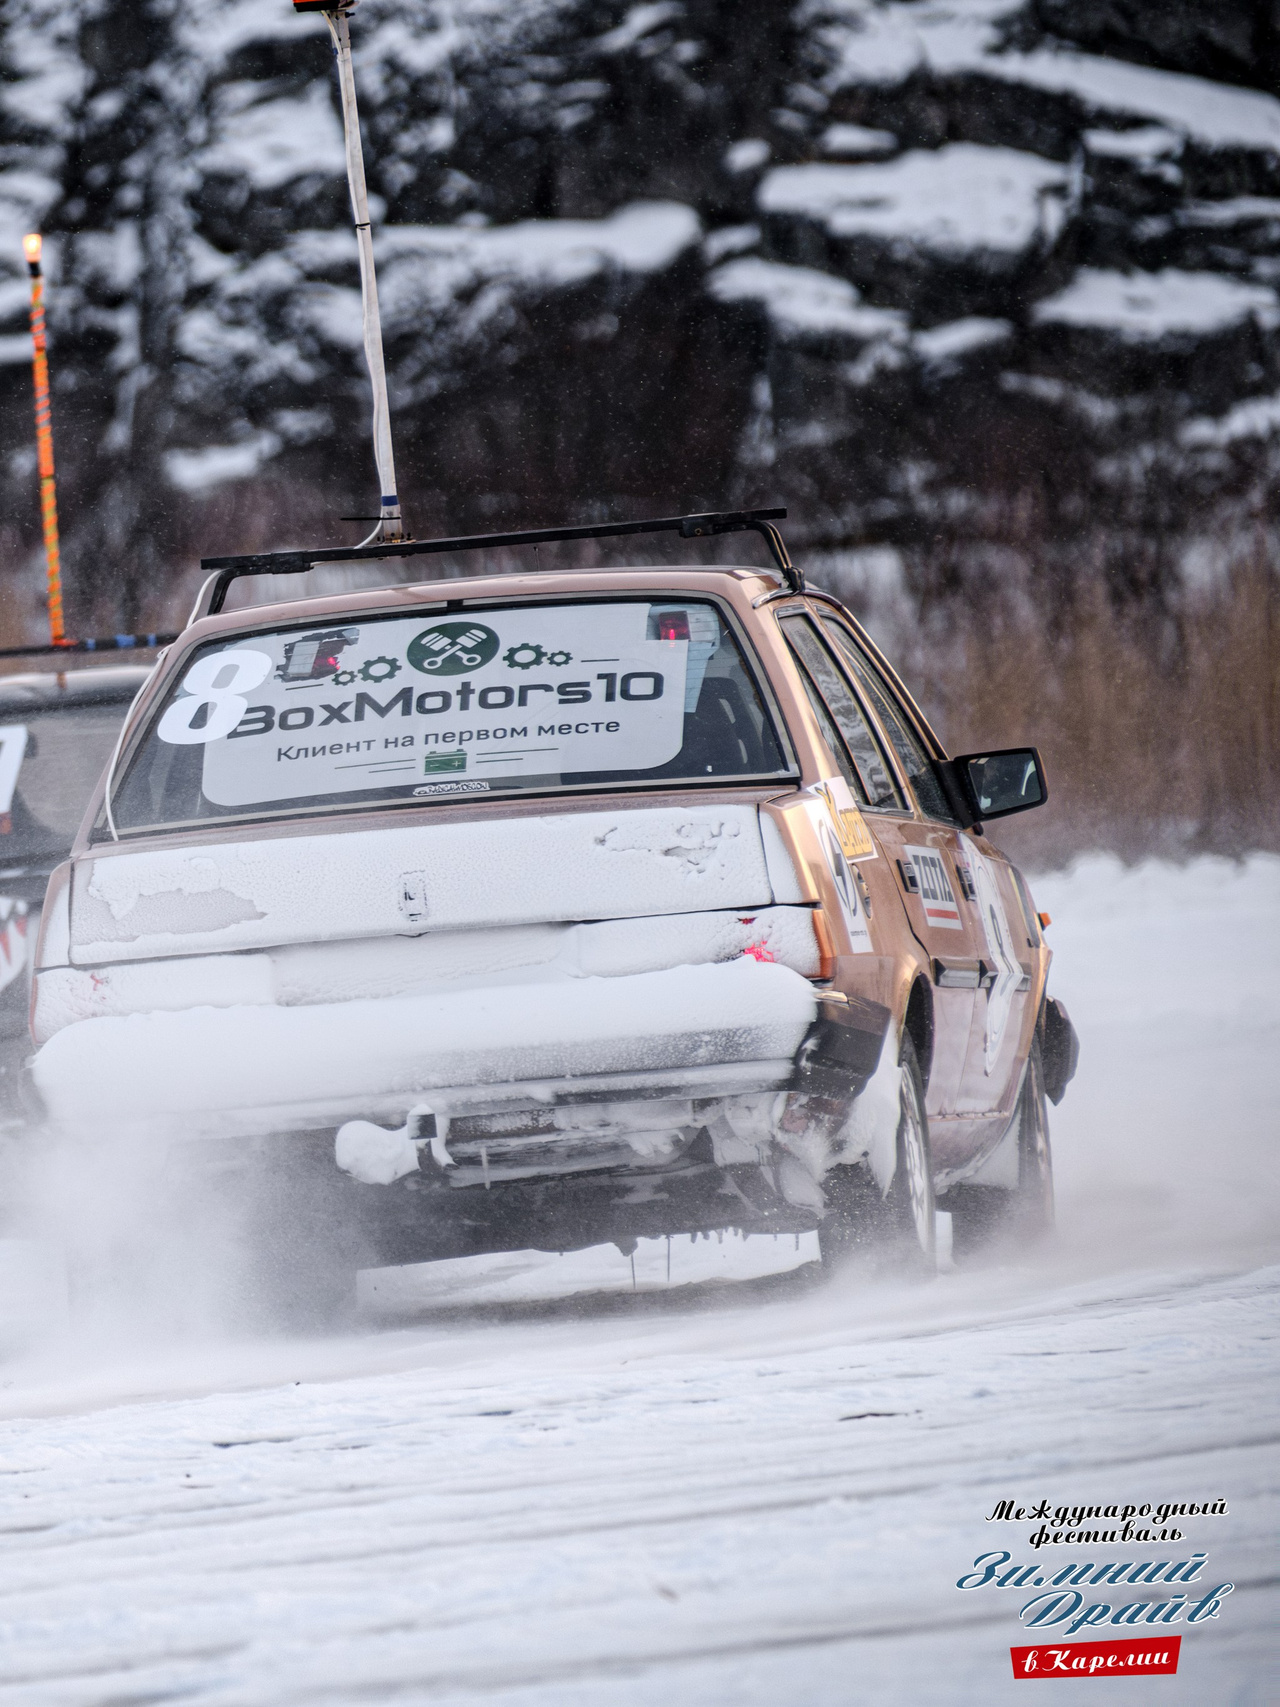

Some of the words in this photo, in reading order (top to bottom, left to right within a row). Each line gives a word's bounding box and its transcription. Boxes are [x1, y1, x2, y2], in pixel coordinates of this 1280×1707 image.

[157, 649, 273, 745] 8
[227, 671, 665, 740] BoxMotors10
[276, 739, 377, 762] Клиент
[383, 735, 415, 750] на
[424, 726, 528, 746] первом
[537, 721, 621, 737] месте
